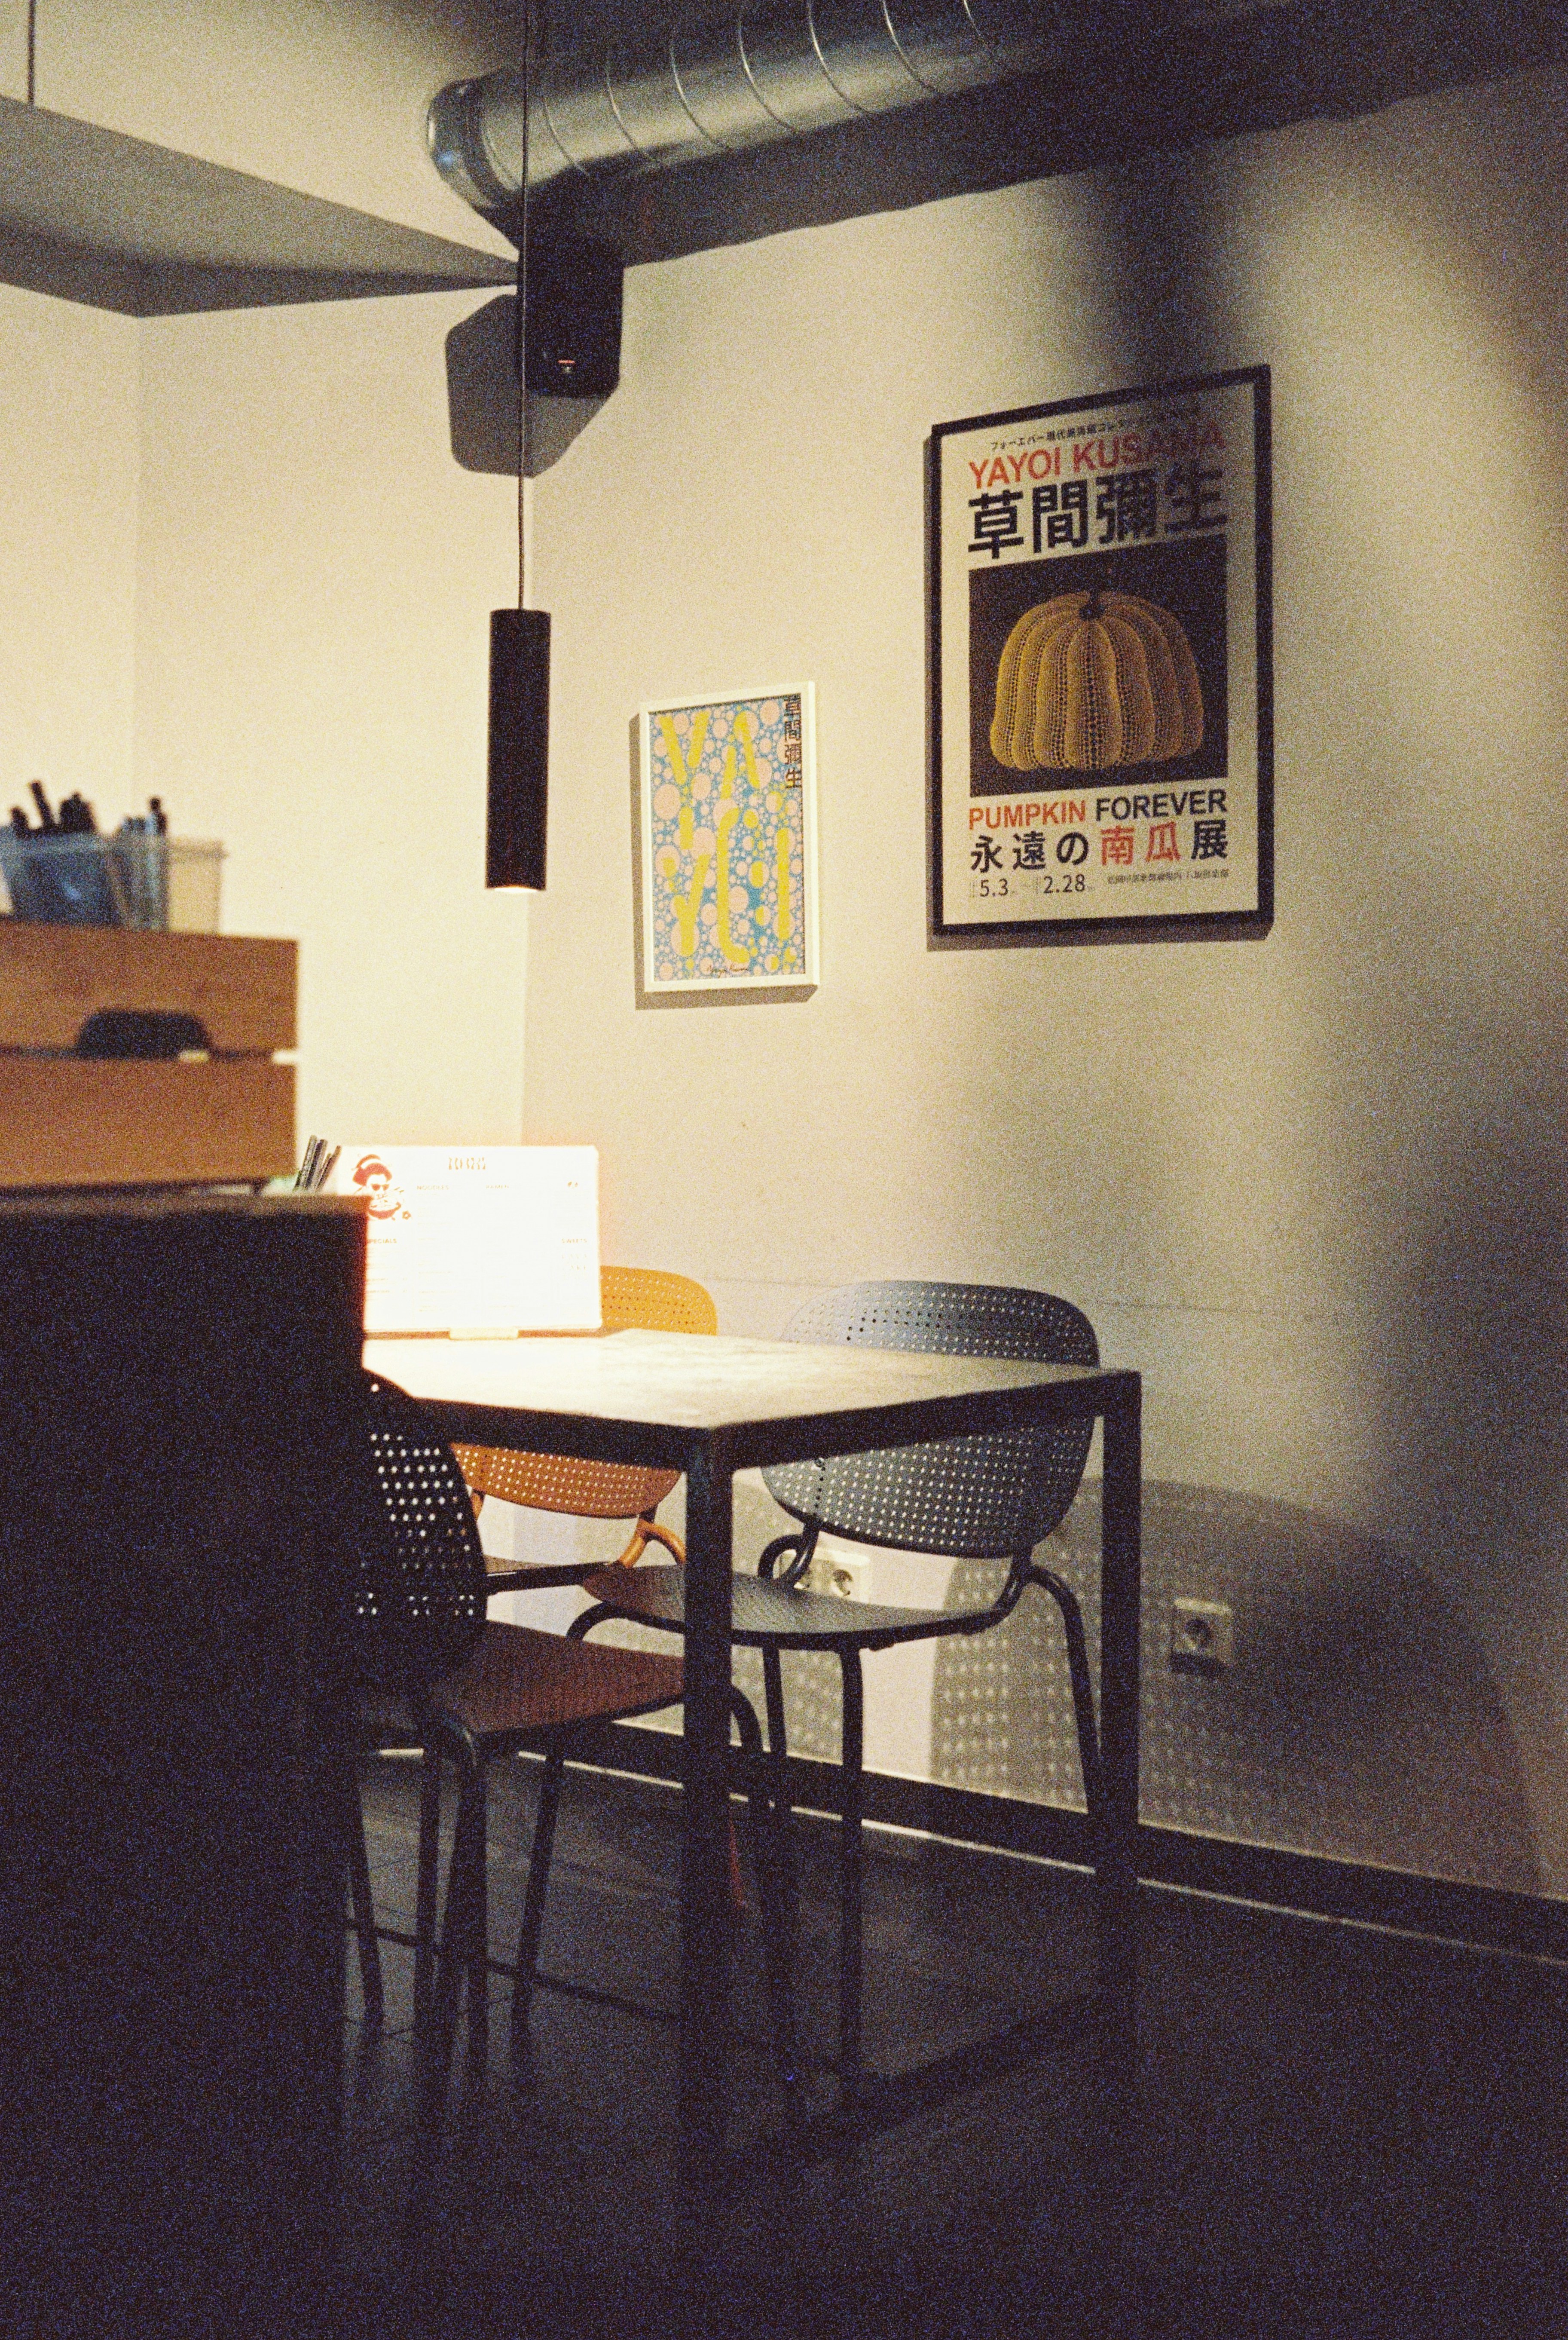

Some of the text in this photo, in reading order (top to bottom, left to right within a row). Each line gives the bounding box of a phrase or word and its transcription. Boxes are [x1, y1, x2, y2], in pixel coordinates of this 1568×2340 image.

[969, 446, 1061, 489] YAYOI
[969, 789, 1227, 830] PUMPKIN FOREVER
[970, 819, 1228, 873] 永遠の南瓜展
[980, 878, 1008, 897] 5.3
[1043, 873, 1085, 894] 2.28
